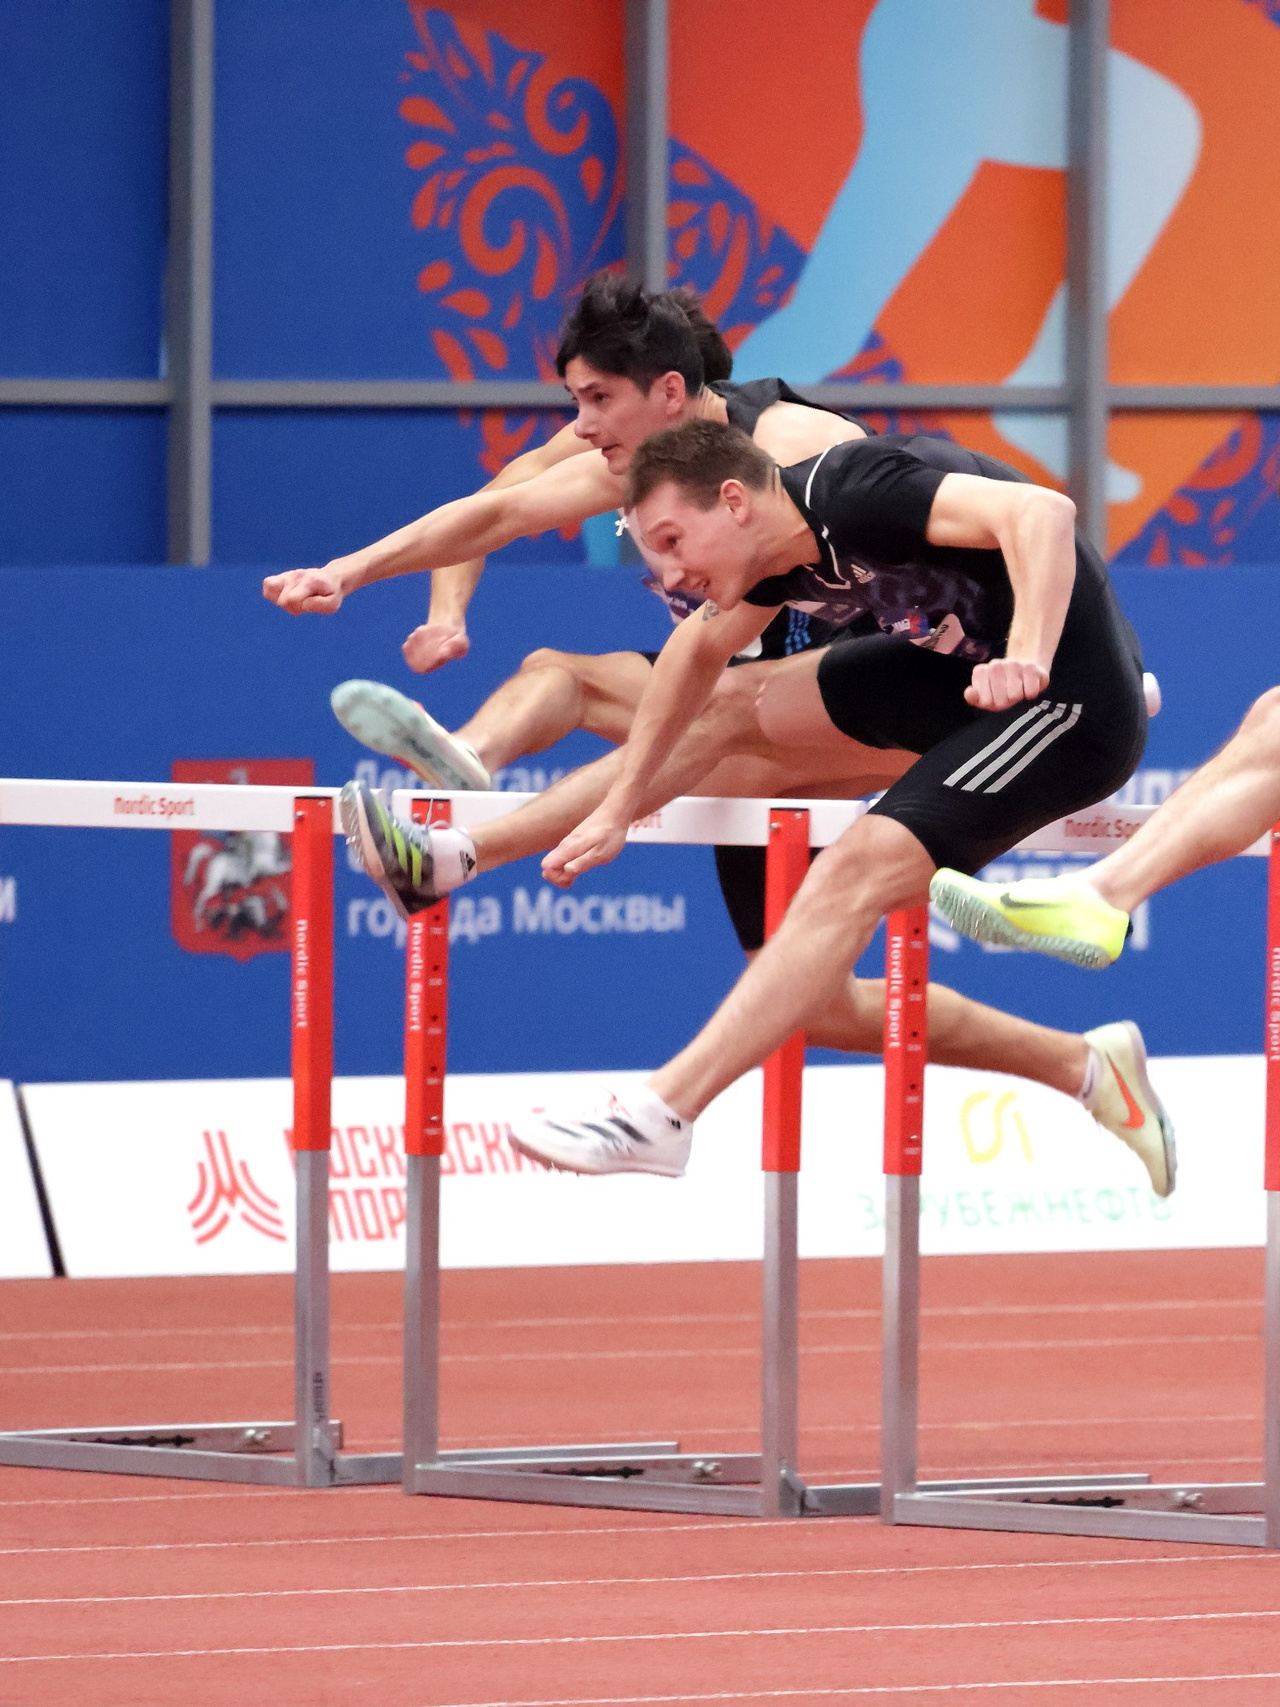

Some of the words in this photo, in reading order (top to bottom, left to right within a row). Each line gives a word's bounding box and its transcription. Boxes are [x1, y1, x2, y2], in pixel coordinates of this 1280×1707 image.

[160, 797, 194, 820] Sport
[513, 886, 686, 935] Москвы
[295, 979, 308, 1028] Sport
[408, 982, 423, 1031] Sport
[888, 998, 902, 1047] Sport
[856, 1187, 1172, 1231] ЗУБЕЖНЕФТЬ
